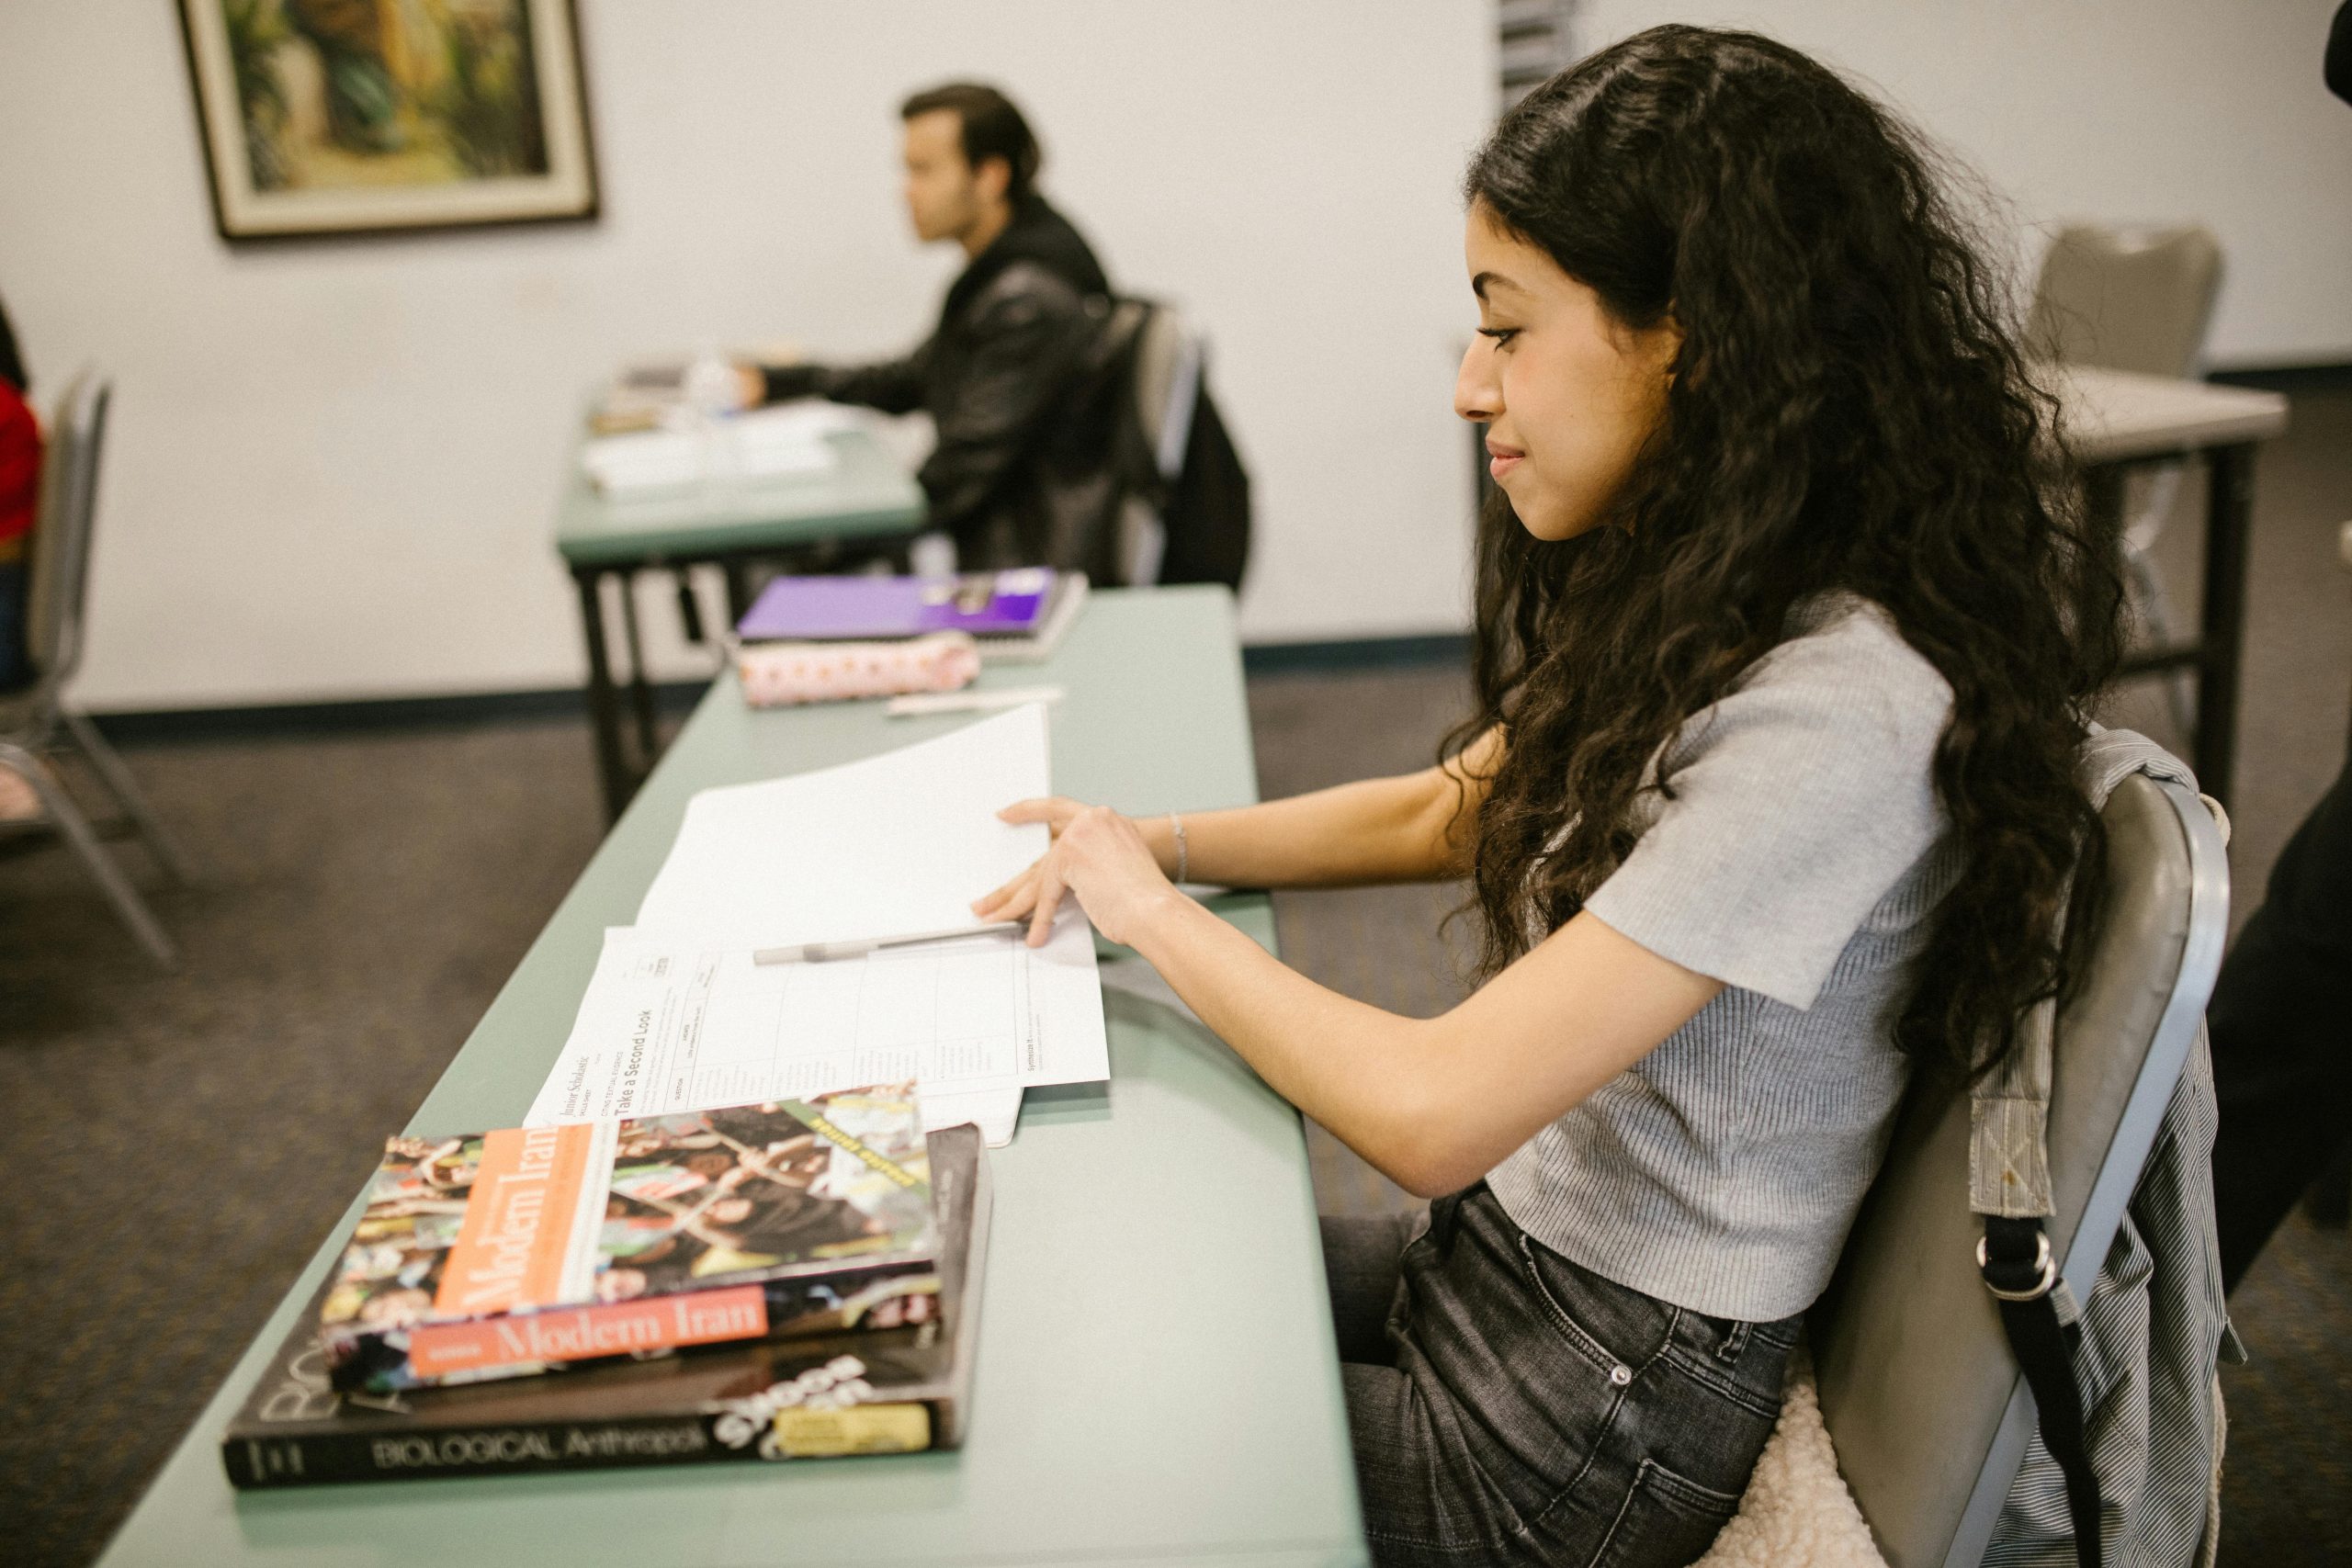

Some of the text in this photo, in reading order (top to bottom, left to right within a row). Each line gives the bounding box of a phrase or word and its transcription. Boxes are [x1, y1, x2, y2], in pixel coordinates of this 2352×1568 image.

[567, 1055, 590, 1092] Scholastic
[615, 1009, 652, 1116] Take a Second Look
[559, 1092, 578, 1118] Junior
[605, 1076, 617, 1100] TEXTUAL
[601, 1100, 611, 1117] CITING
[461, 1126, 560, 1305] Modern Iran
[495, 1301, 759, 1362] Modern Iran
[371, 1430, 559, 1469] BIOLOGICAL
